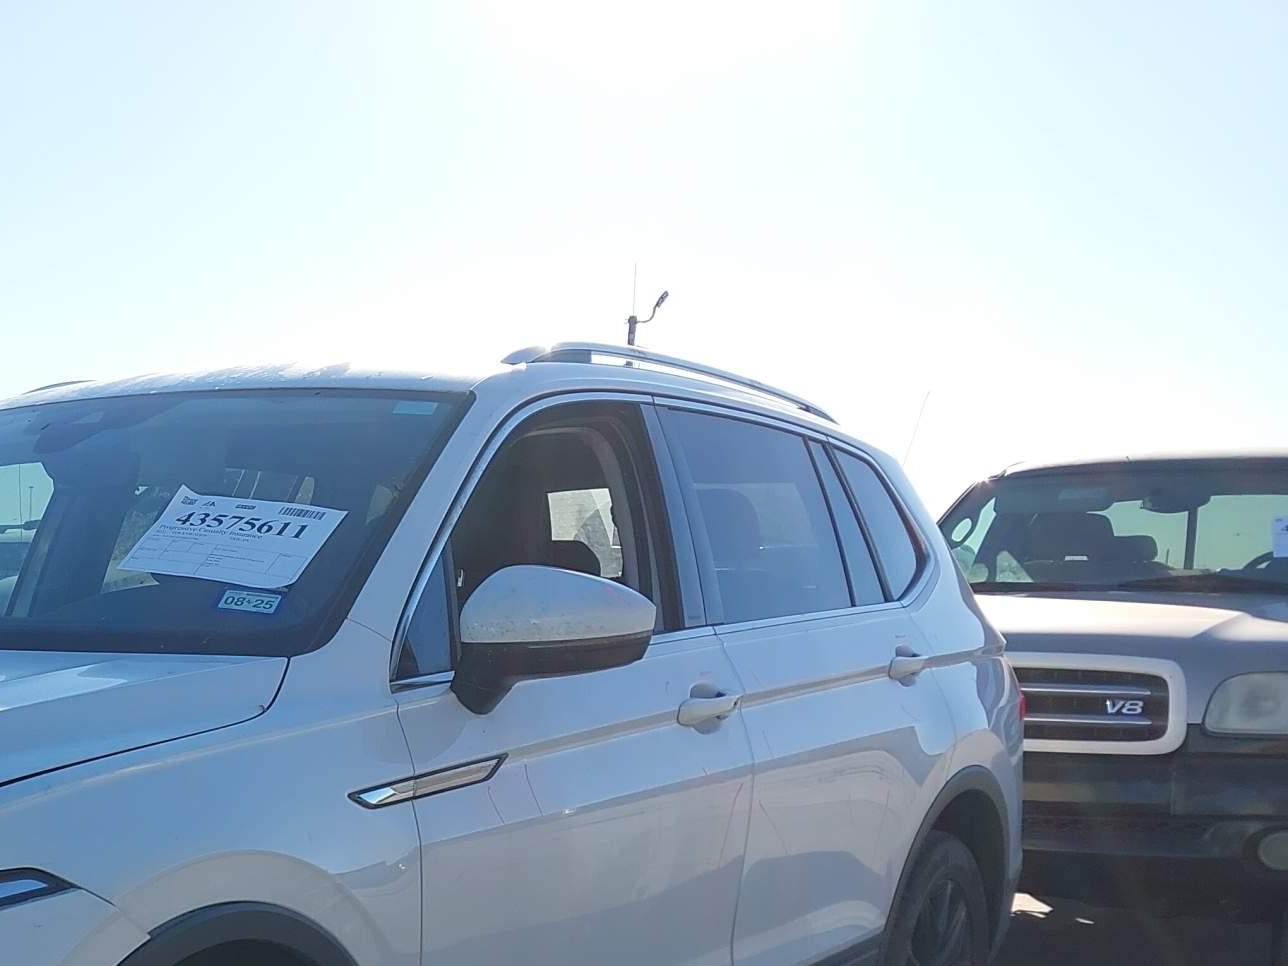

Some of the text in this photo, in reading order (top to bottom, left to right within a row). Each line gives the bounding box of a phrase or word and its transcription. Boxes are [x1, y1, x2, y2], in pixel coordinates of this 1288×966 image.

[175, 511, 310, 539] 43575611
[224, 595, 246, 607] 08
[251, 599, 275, 610] 25
[1106, 700, 1144, 714] V8
